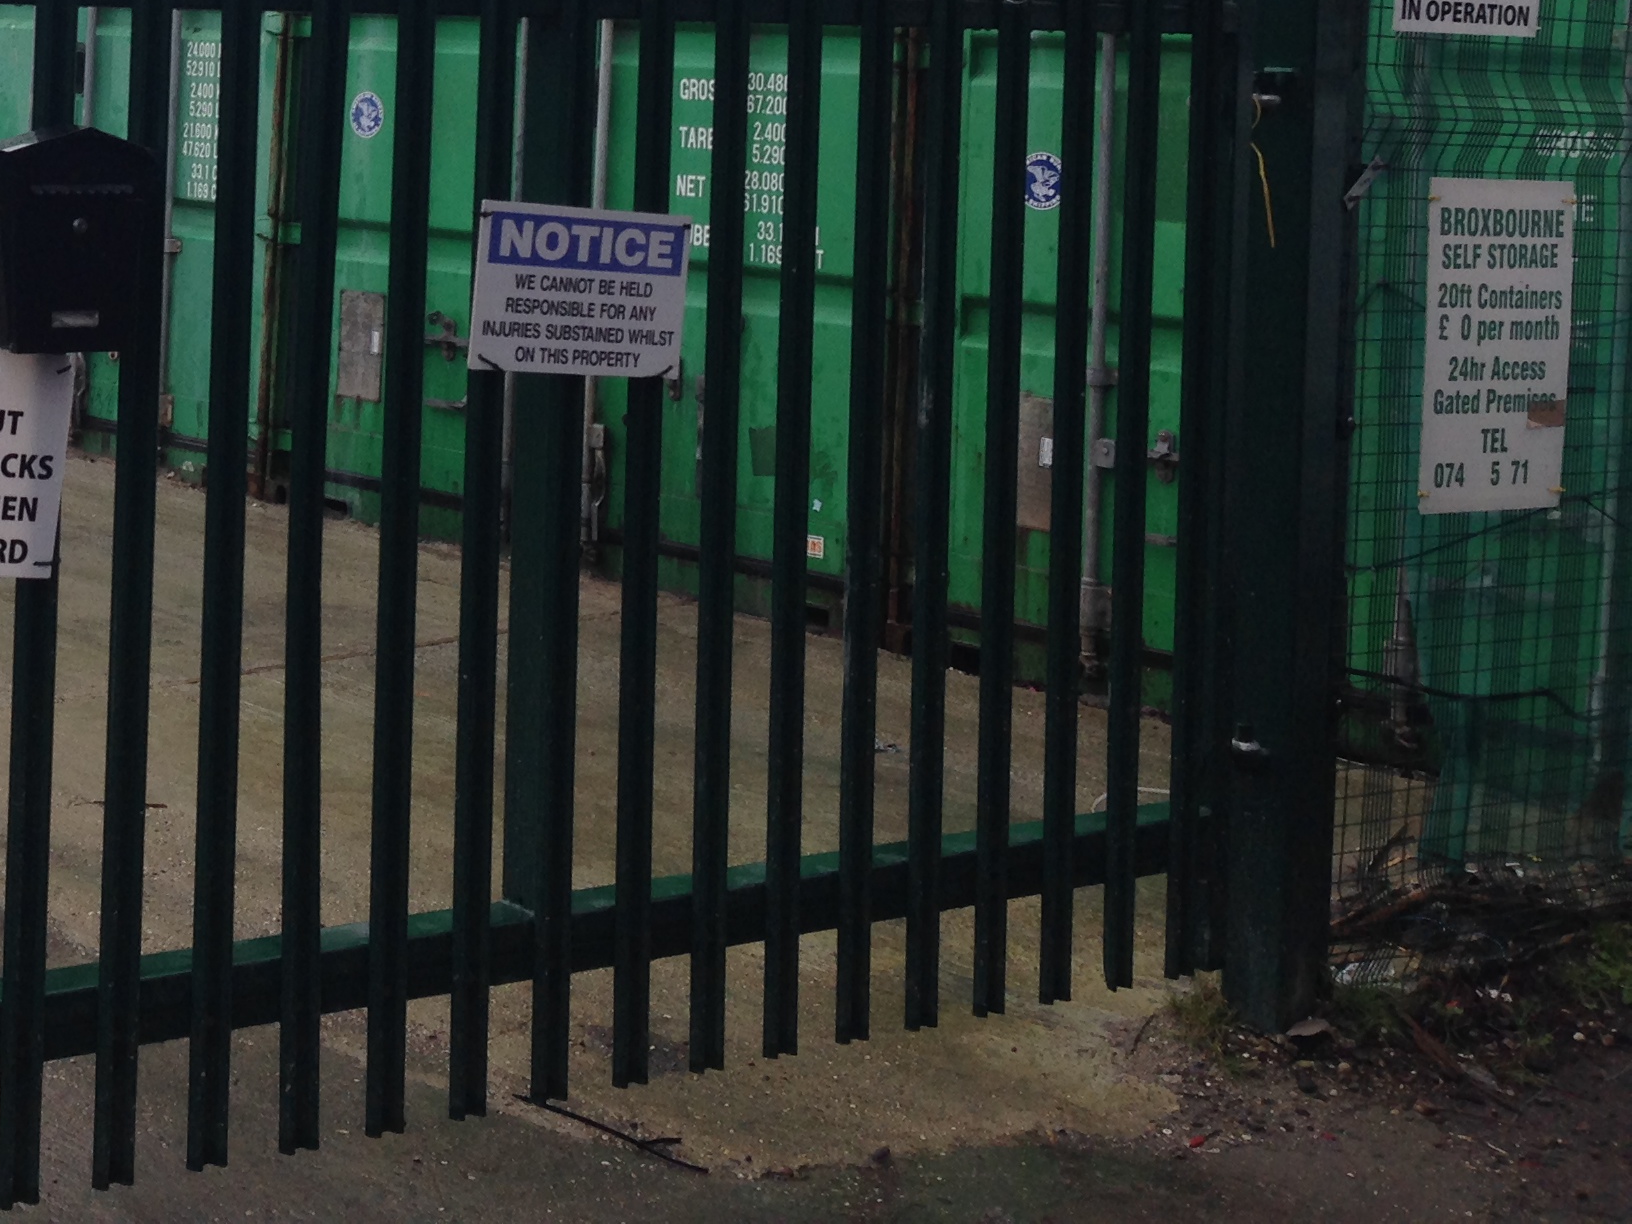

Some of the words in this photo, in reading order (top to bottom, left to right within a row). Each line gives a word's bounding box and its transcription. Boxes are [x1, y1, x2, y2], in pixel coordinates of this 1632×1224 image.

[1425, 0, 1530, 27] OPERATION
[679, 78, 715, 101] GROS
[679, 126, 713, 150] TARE
[676, 174, 706, 198] NET
[1439, 206, 1565, 238] BROXBOURNE
[498, 218, 675, 269] NOTICE
[1441, 243, 1482, 270] SELF
[1486, 243, 1559, 270] STORAGE
[514, 273, 536, 290] WE
[540, 276, 595, 294] CANNOT
[598, 279, 616, 296] BE
[619, 281, 654, 298] HELD
[1437, 282, 1472, 309] 20ft
[1477, 282, 1563, 310] Containers
[505, 297, 595, 318] RESPONSIBLE
[599, 303, 626, 320] FOR
[629, 305, 657, 322] ANY
[481, 320, 541, 339] INJURIES
[544, 323, 625, 344] SUBSTAINED
[628, 330, 675, 347] WHILST
[1438, 313, 1450, 341] £
[1476, 319, 1505, 347] per
[1509, 314, 1560, 341] month
[514, 346, 535, 363] ON
[539, 347, 569, 365] THIS
[571, 349, 641, 368] PROPERTY
[1447, 355, 1486, 382] 24hr
[1490, 355, 1546, 381] Access
[1433, 388, 1481, 415] Gated
[1485, 387, 1557, 414] Premises
[1481, 427, 1508, 454] TEL
[1433, 462, 1465, 489] 074
[1510, 459, 1529, 485] 71
